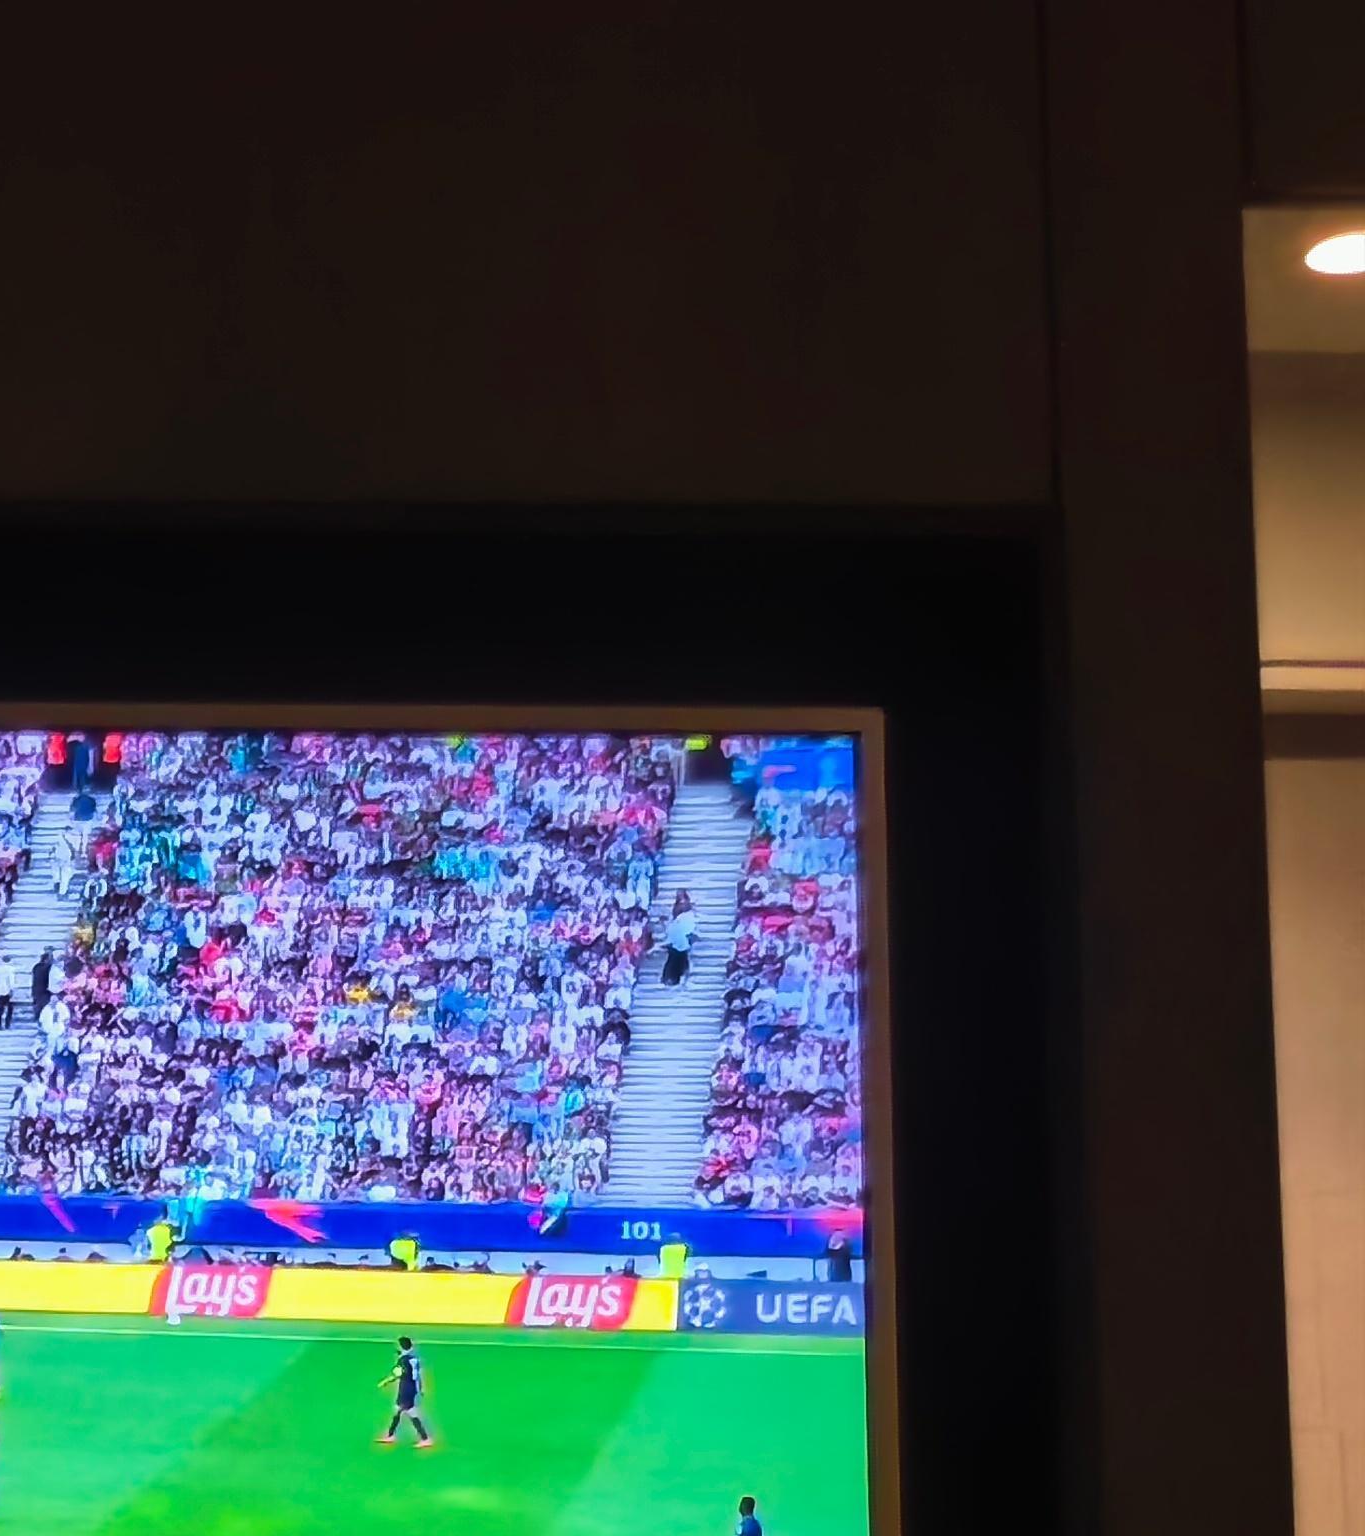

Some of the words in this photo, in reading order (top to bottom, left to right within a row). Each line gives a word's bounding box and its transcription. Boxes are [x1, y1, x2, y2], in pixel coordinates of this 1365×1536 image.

[620, 1220, 661, 1240] 101
[165, 1265, 257, 1316] Lay's
[522, 1275, 621, 1328] Lay's
[756, 1292, 857, 1325] UEFA
